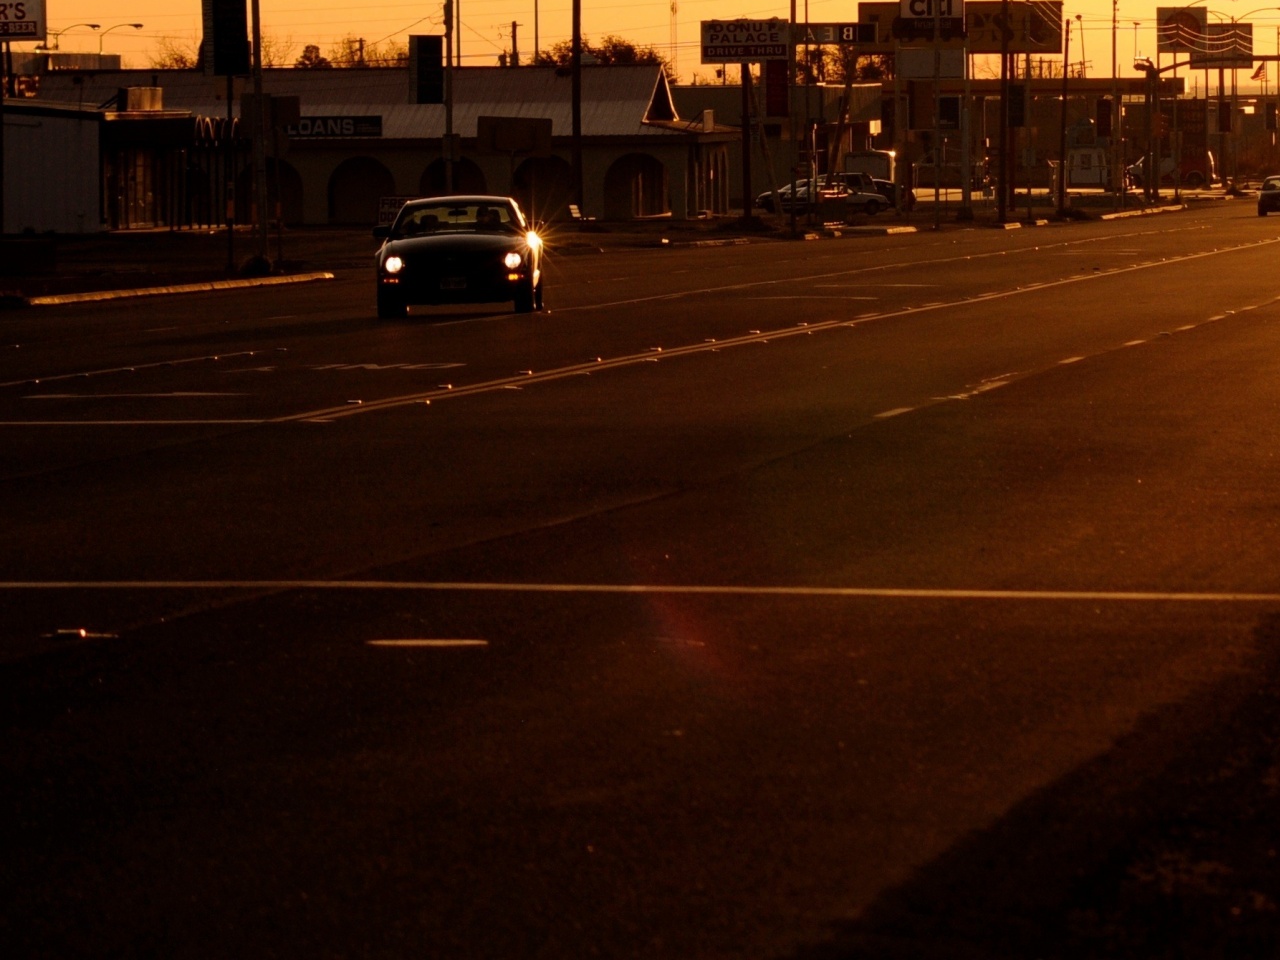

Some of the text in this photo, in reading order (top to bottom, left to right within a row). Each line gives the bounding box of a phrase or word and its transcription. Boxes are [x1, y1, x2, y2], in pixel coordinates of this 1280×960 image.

[713, 22, 778, 33] DONUT
[710, 33, 779, 43] PALACE
[708, 46, 783, 55] DRIVE THRU
[286, 119, 355, 135] LOANS
